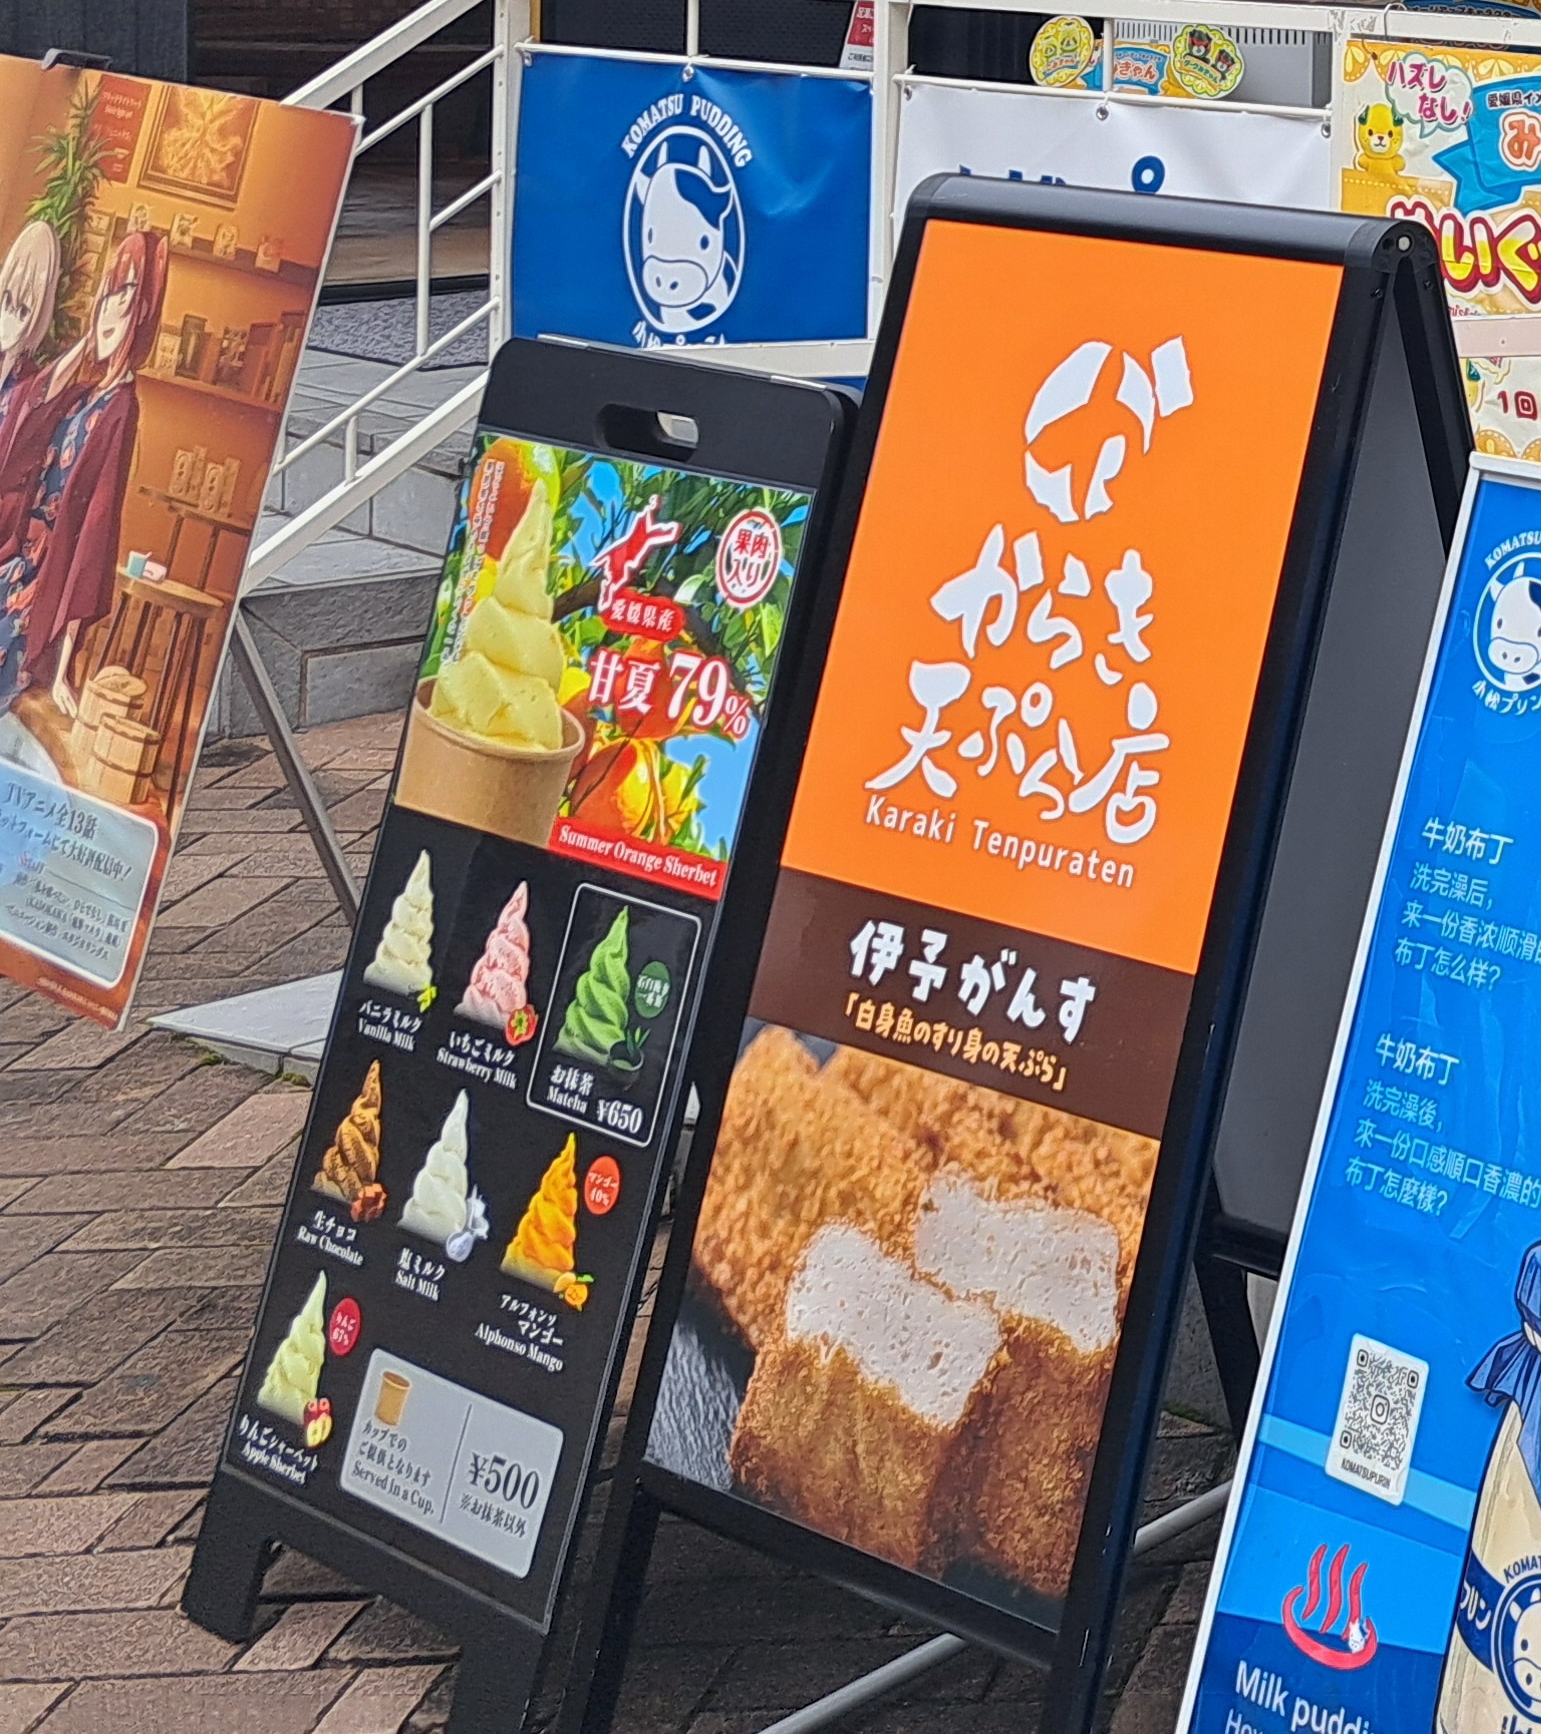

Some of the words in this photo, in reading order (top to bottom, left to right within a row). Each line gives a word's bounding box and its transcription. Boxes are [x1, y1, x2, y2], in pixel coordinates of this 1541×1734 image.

[1386, 58, 1447, 96] ハズレ
[621, 94, 684, 159] KOMATSU
[689, 94, 754, 168] PUDDING
[1497, 389, 1539, 422] 1回
[733, 527, 767, 557] 果肉
[727, 558, 762, 590] 入り
[609, 597, 674, 633] 愛媛県産
[931, 524, 1156, 687] からき
[586, 649, 661, 716] 甘夏
[667, 652, 751, 740] 79%
[863, 660, 1170, 846] 天ぷら店
[558, 824, 610, 856] Summer
[613, 840, 662, 872] Orange
[664, 854, 718, 888] Sherbet
[865, 795, 956, 845] Karaki
[971, 819, 1135, 889] Tenpuraten
[1421, 816, 1514, 865] 牛奶布丁
[848, 919, 1097, 1047] 伊予がんす
[357, 1018, 391, 1047] Vanilla
[391, 1029, 417, 1053] Milk
[358, 999, 423, 1034] バニラミルク
[436, 1046, 493, 1084] Strawberry
[449, 1031, 516, 1067] いちごミルク
[1374, 1032, 1462, 1085] 牛奶布丁
[546, 1084, 588, 1115] Matcha
[596, 1098, 644, 1135] ¥650
[296, 1222, 321, 1245] Raw
[394, 1268, 417, 1292] Salt
[415, 1278, 440, 1303] Milk
[474, 1322, 525, 1360] Alphonso
[526, 1342, 564, 1373] Mango
[241, 1442, 271, 1470] Apple
[352, 1460, 388, 1489] Served
[468, 1452, 540, 1510] ¥500
[1235, 1660, 1288, 1718] Milk
[1290, 1696, 1374, 1734] puddi
